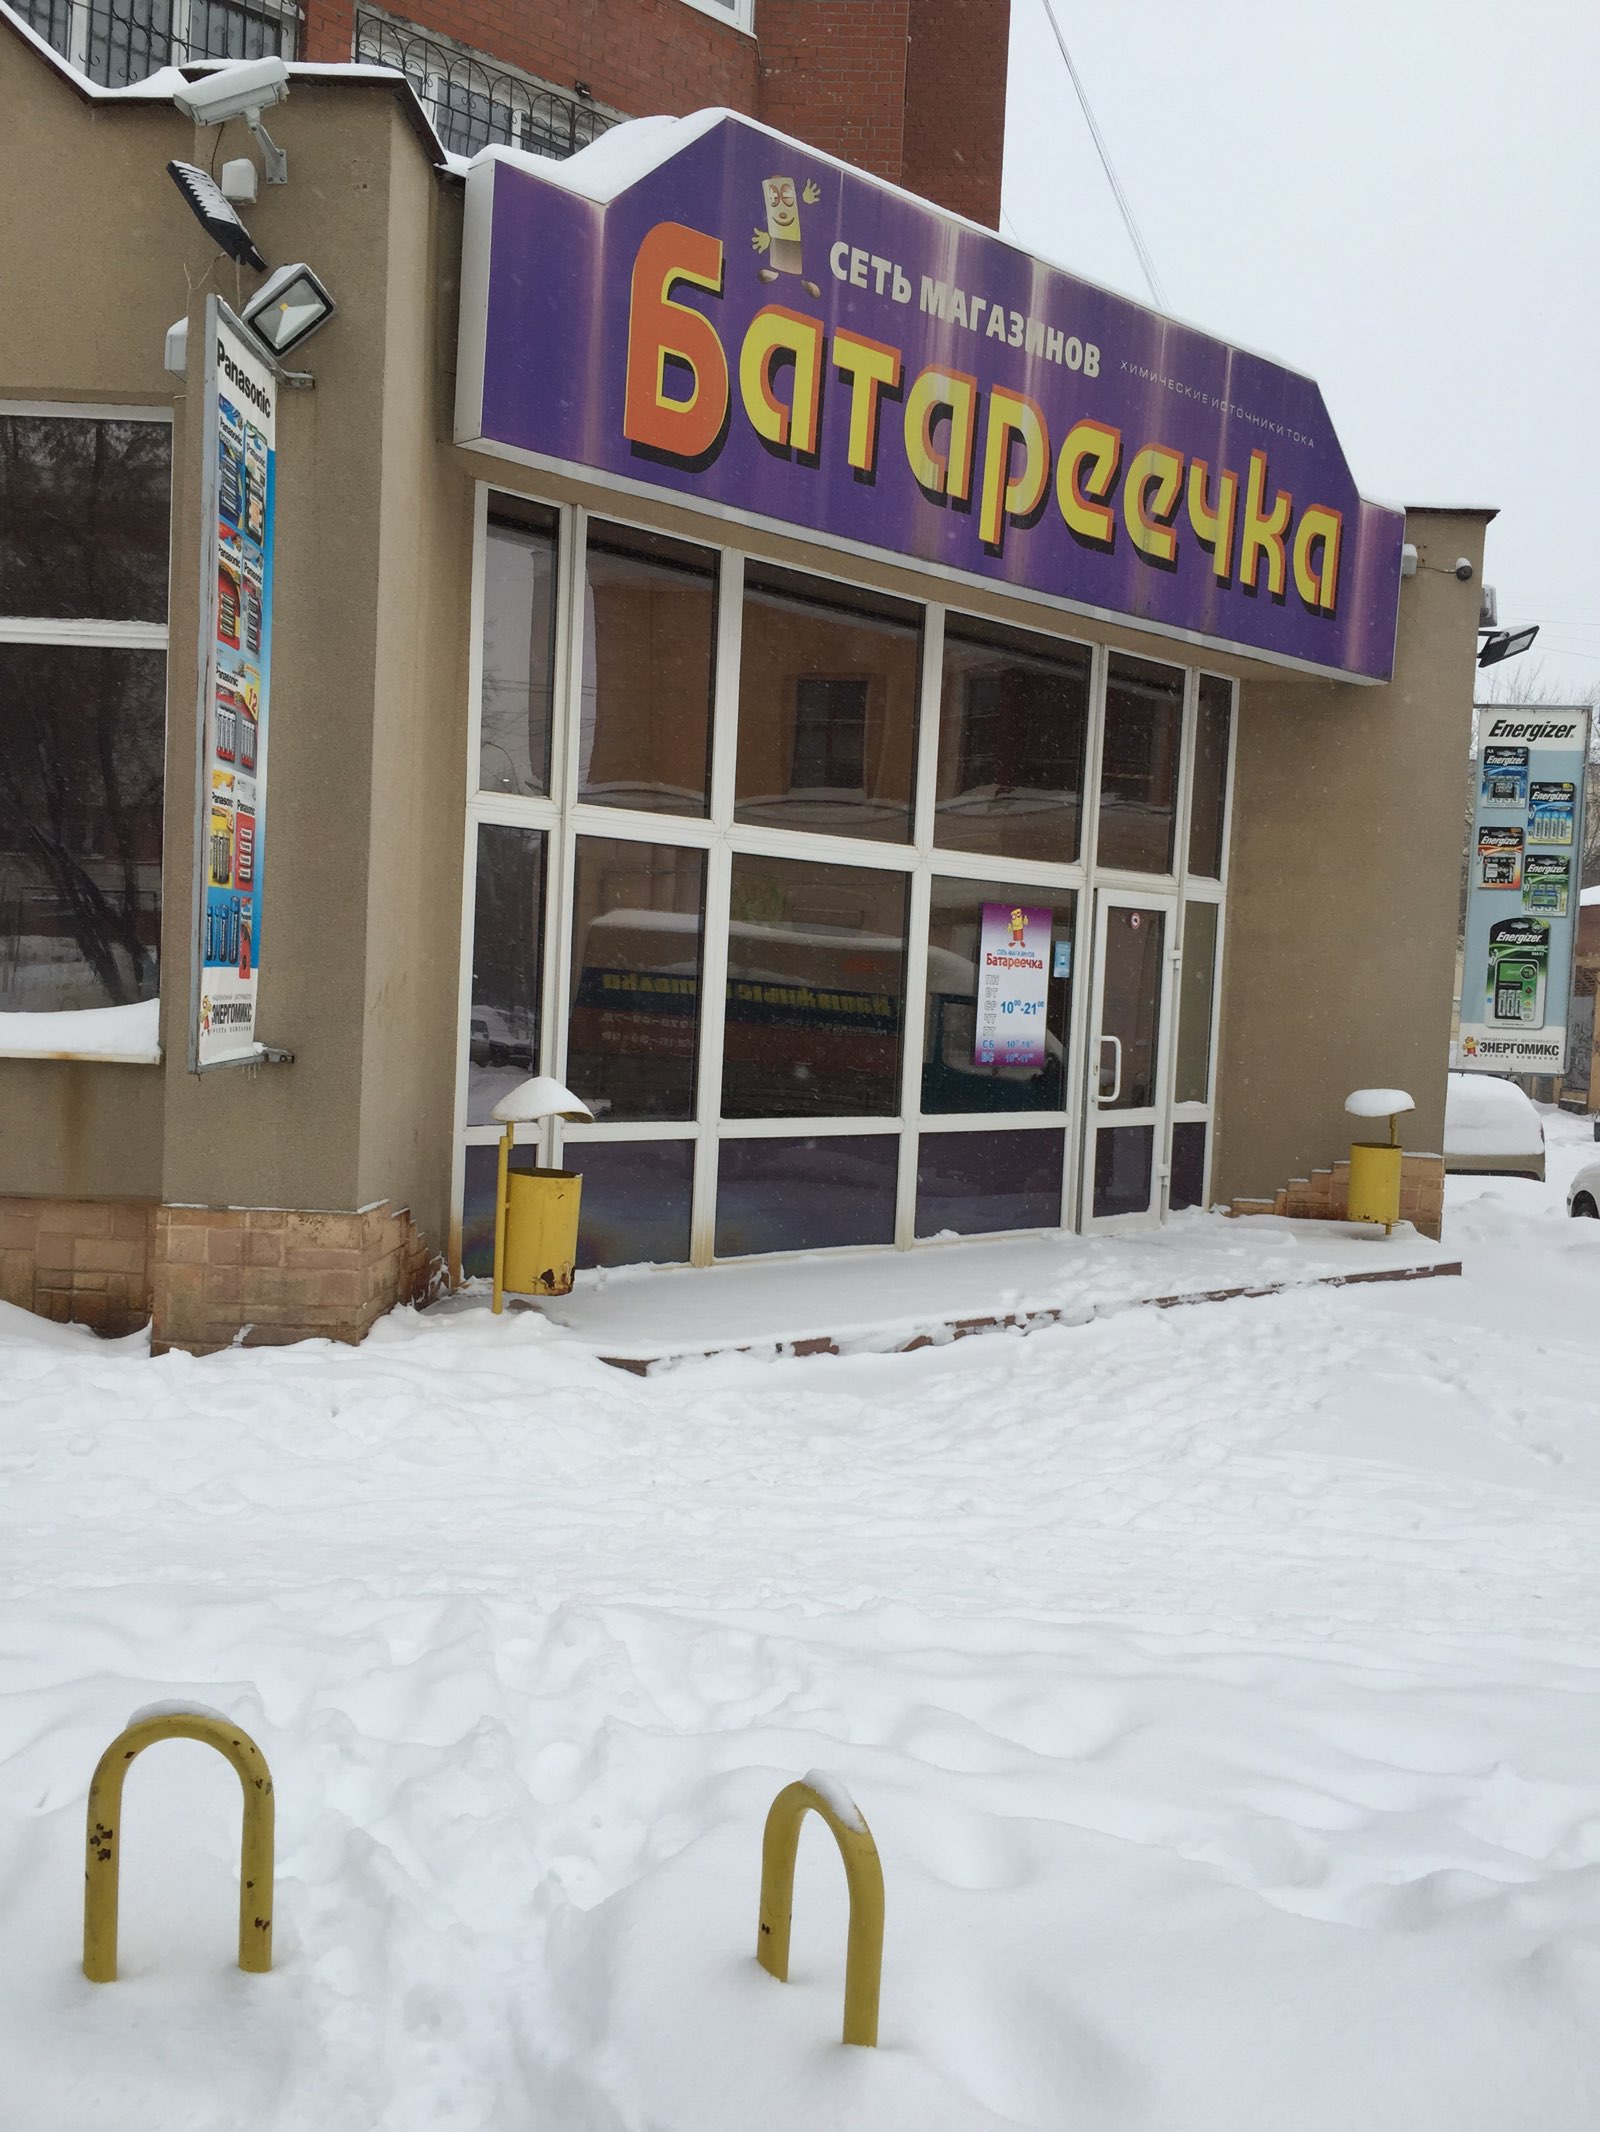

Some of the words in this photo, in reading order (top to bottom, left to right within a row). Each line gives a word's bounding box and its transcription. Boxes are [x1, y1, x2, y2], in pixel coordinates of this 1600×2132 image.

[829, 240, 913, 306] СЕТЬ
[919, 275, 1101, 379] МАГАЗИНОВ
[217, 337, 271, 419] Panasonic
[1120, 359, 1209, 404] ХИМИЧЕСКИЕ
[1210, 397, 1285, 436] ИСТОЧНИКИ
[1286, 428, 1315, 449] ТОКА
[623, 220, 1343, 613] Батареечка
[248, 687, 258, 714] 12
[1488, 719, 1577, 742] Energizer
[1486, 755, 1525, 767] Energizer
[1531, 791, 1571, 802] Energizer
[1480, 835, 1520, 847] Energizer
[1527, 864, 1567, 875] Energizer
[1496, 931, 1543, 944] Energizer
[986, 952, 1043, 970] Батареечка
[211, 1002, 253, 1025] ЭНЕРГОМИКС
[984, 1000, 998, 1011] СР
[1479, 1041, 1560, 1056] ЭНЕРГОМИКС
